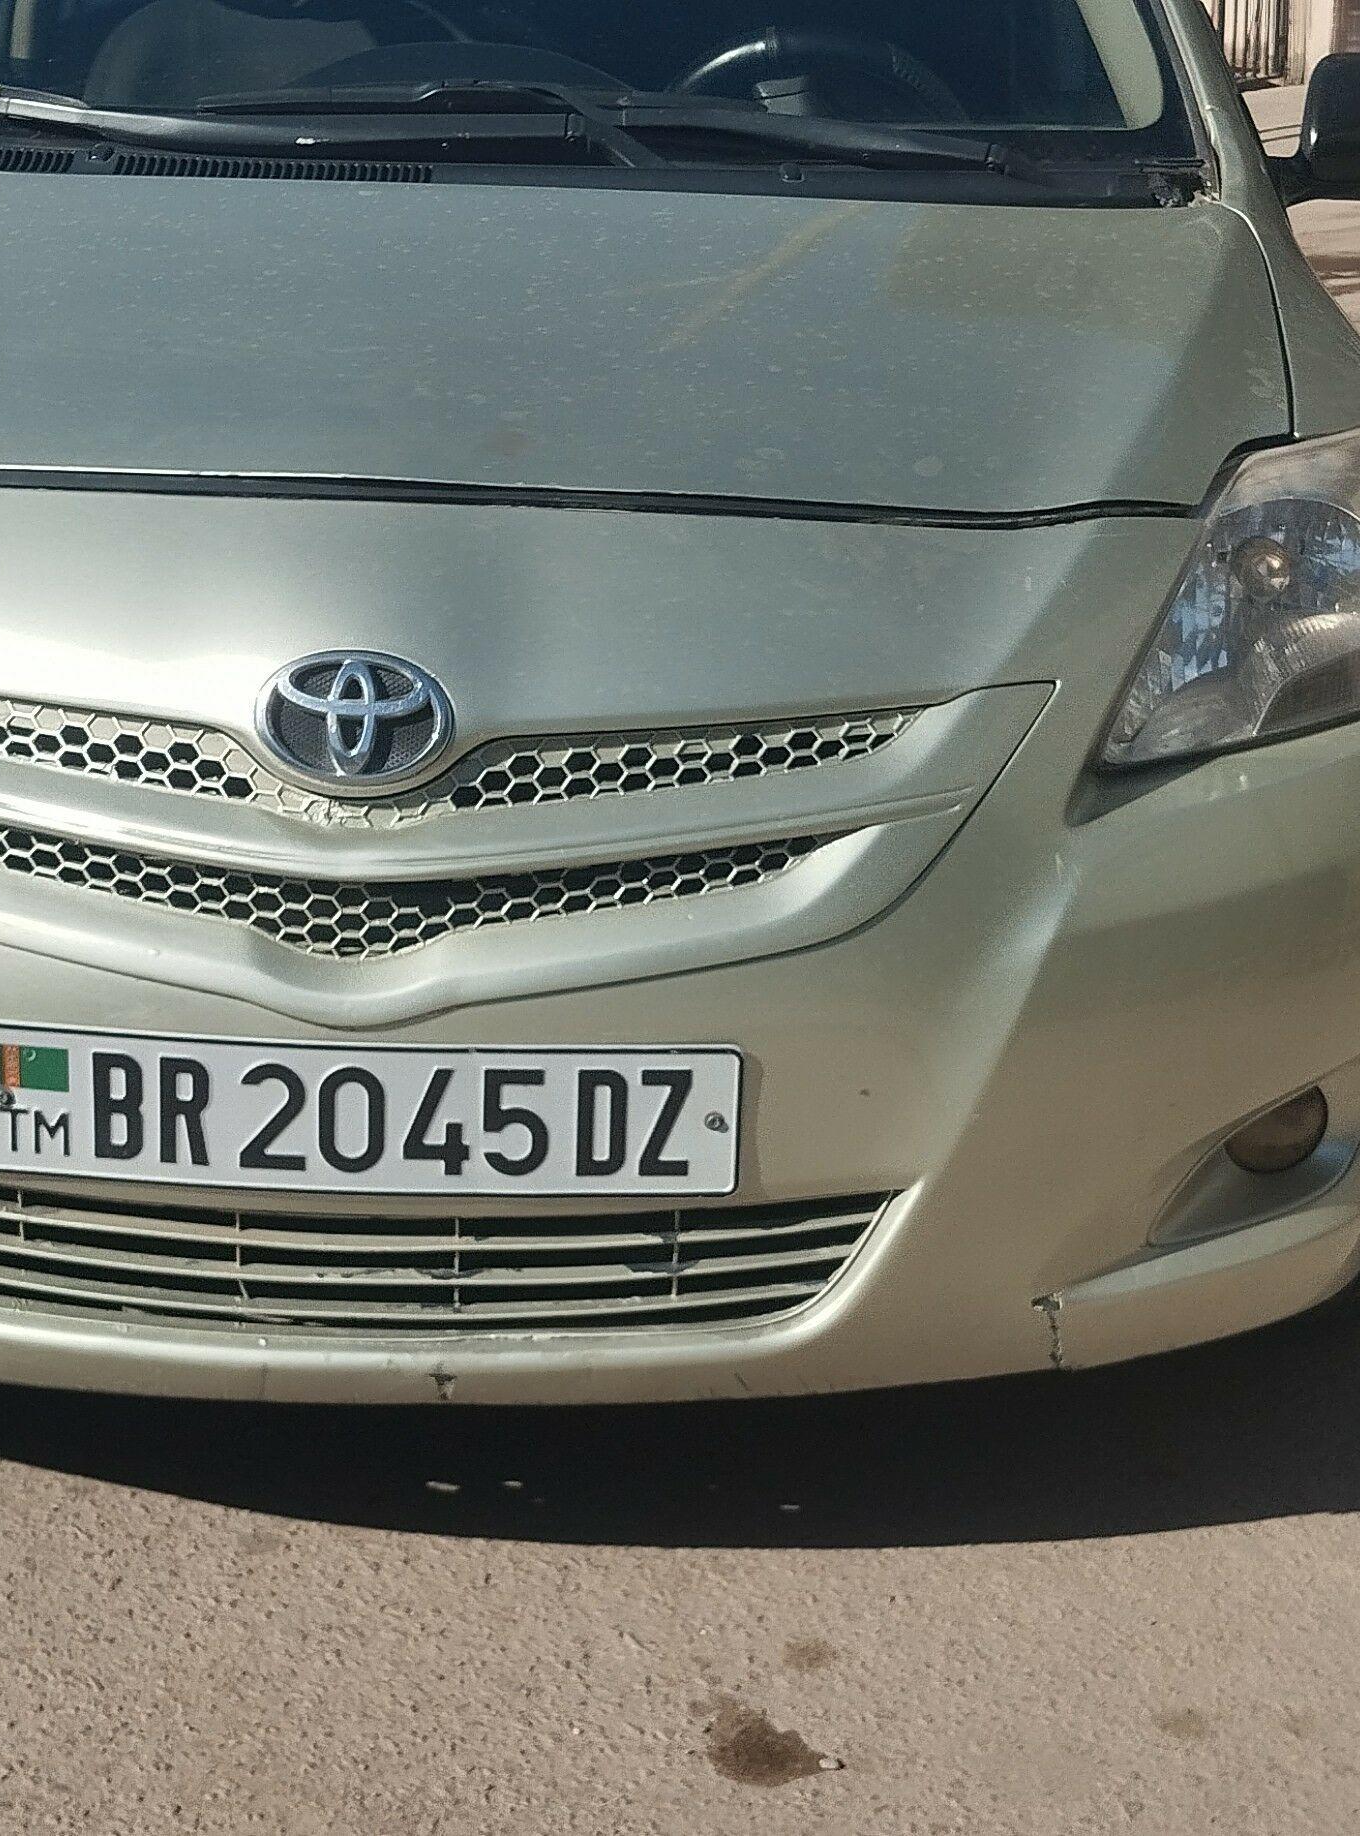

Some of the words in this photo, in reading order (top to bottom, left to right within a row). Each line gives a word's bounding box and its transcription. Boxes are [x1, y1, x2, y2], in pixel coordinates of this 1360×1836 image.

[0, 1104, 71, 1157] TM
[91, 1051, 211, 1166] BR
[238, 1062, 550, 1178] 2045
[574, 1068, 694, 1178] DZ
